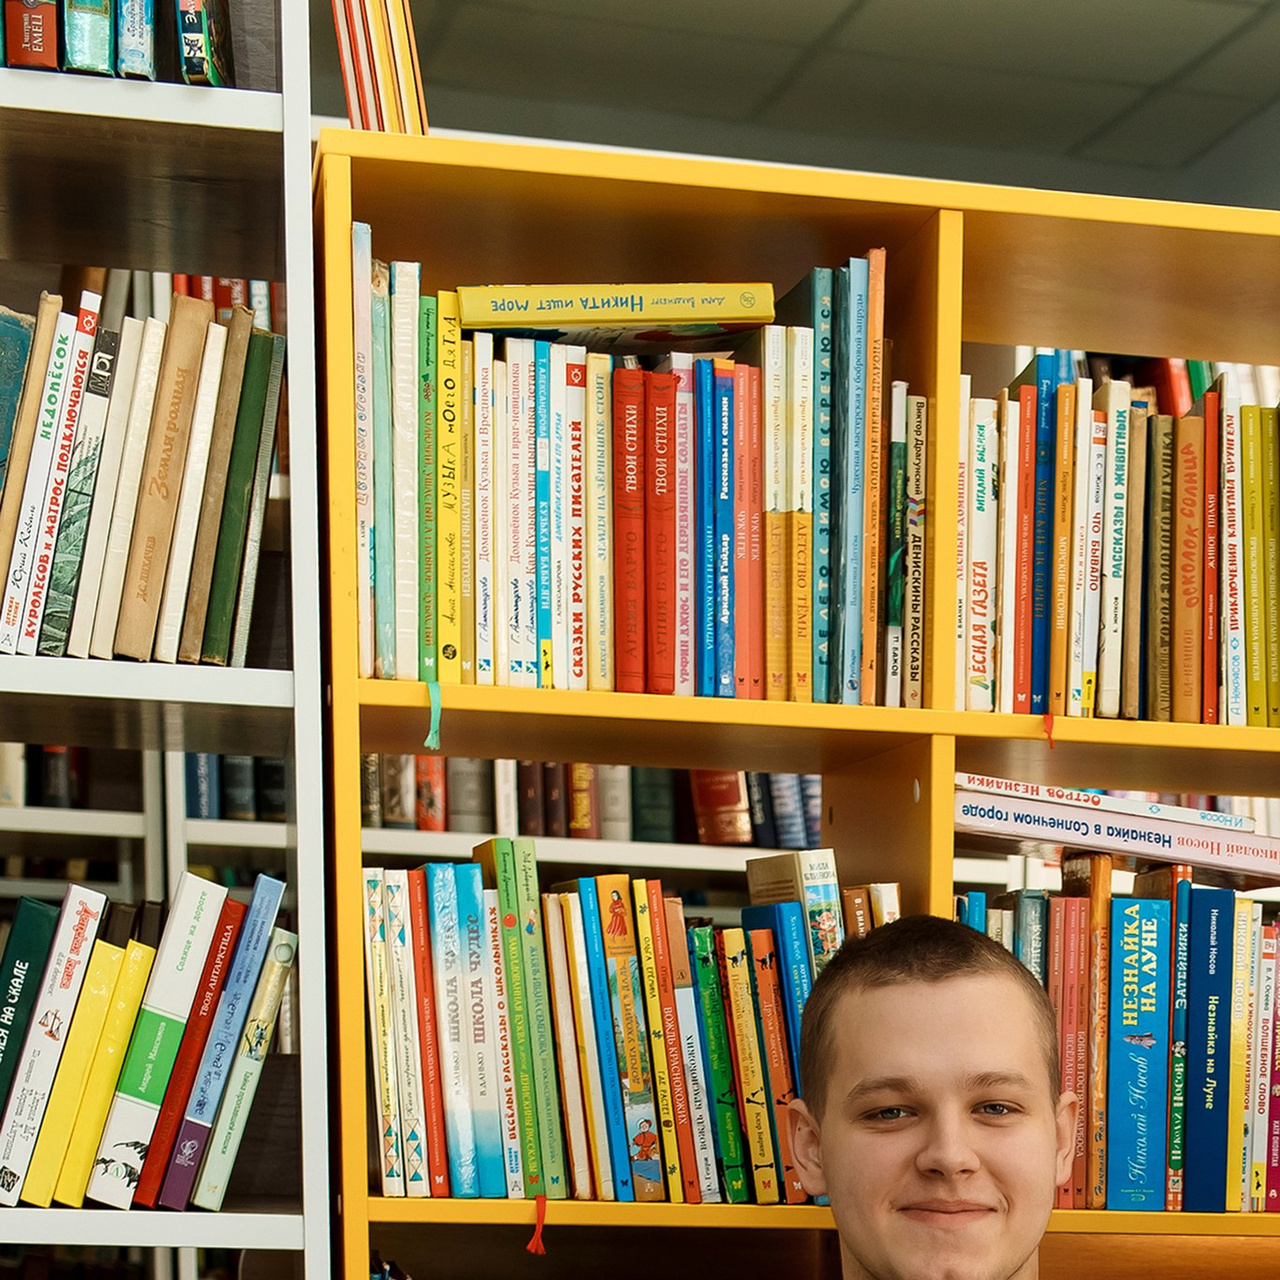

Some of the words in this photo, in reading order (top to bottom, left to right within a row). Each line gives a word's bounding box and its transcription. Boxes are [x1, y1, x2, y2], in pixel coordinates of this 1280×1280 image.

[32, 14, 44, 52] ЕМЕЦ
[39, 333, 69, 440] НЕДОПЁСОК
[624, 405, 637, 450] СТИХИ
[1114, 410, 1127, 487] ЖИВОТНЫХ
[1226, 414, 1235, 473] ВРУНГЕЛЯ
[25, 554, 50, 638] КУРОЛЕСОВ
[45, 478, 63, 538] МАТРОС
[56, 349, 89, 472] ПОДКЛЮЧАЮТСЯ
[478, 451, 492, 491] Кузька
[625, 455, 637, 492] ТВОИ
[1227, 479, 1237, 537] КАПИТАНА
[720, 534, 730, 572] Гайдар
[1112, 506, 1124, 578] РАССКАЗЫ
[720, 575, 729, 623] Аркадий
[910, 534, 922, 613] ДЕНИСКИНЫ
[971, 560, 988, 617] ГАЗЕТА
[1228, 542, 1239, 631] ПРИКЛЮЧЕНИЯ
[910, 616, 921, 681] РАССКАЗЫ
[199, 991, 212, 1017] ТВОЯ
[206, 924, 233, 989] АНТАРКТИДА
[1123, 905, 1140, 1026] НЕЗНАЙКА
[1143, 918, 1158, 976] ЛУНЕ
[471, 978, 486, 1043] ШКОЛА
[1142, 982, 1156, 1012] НА
[1127, 1053, 1148, 1110] Носов
